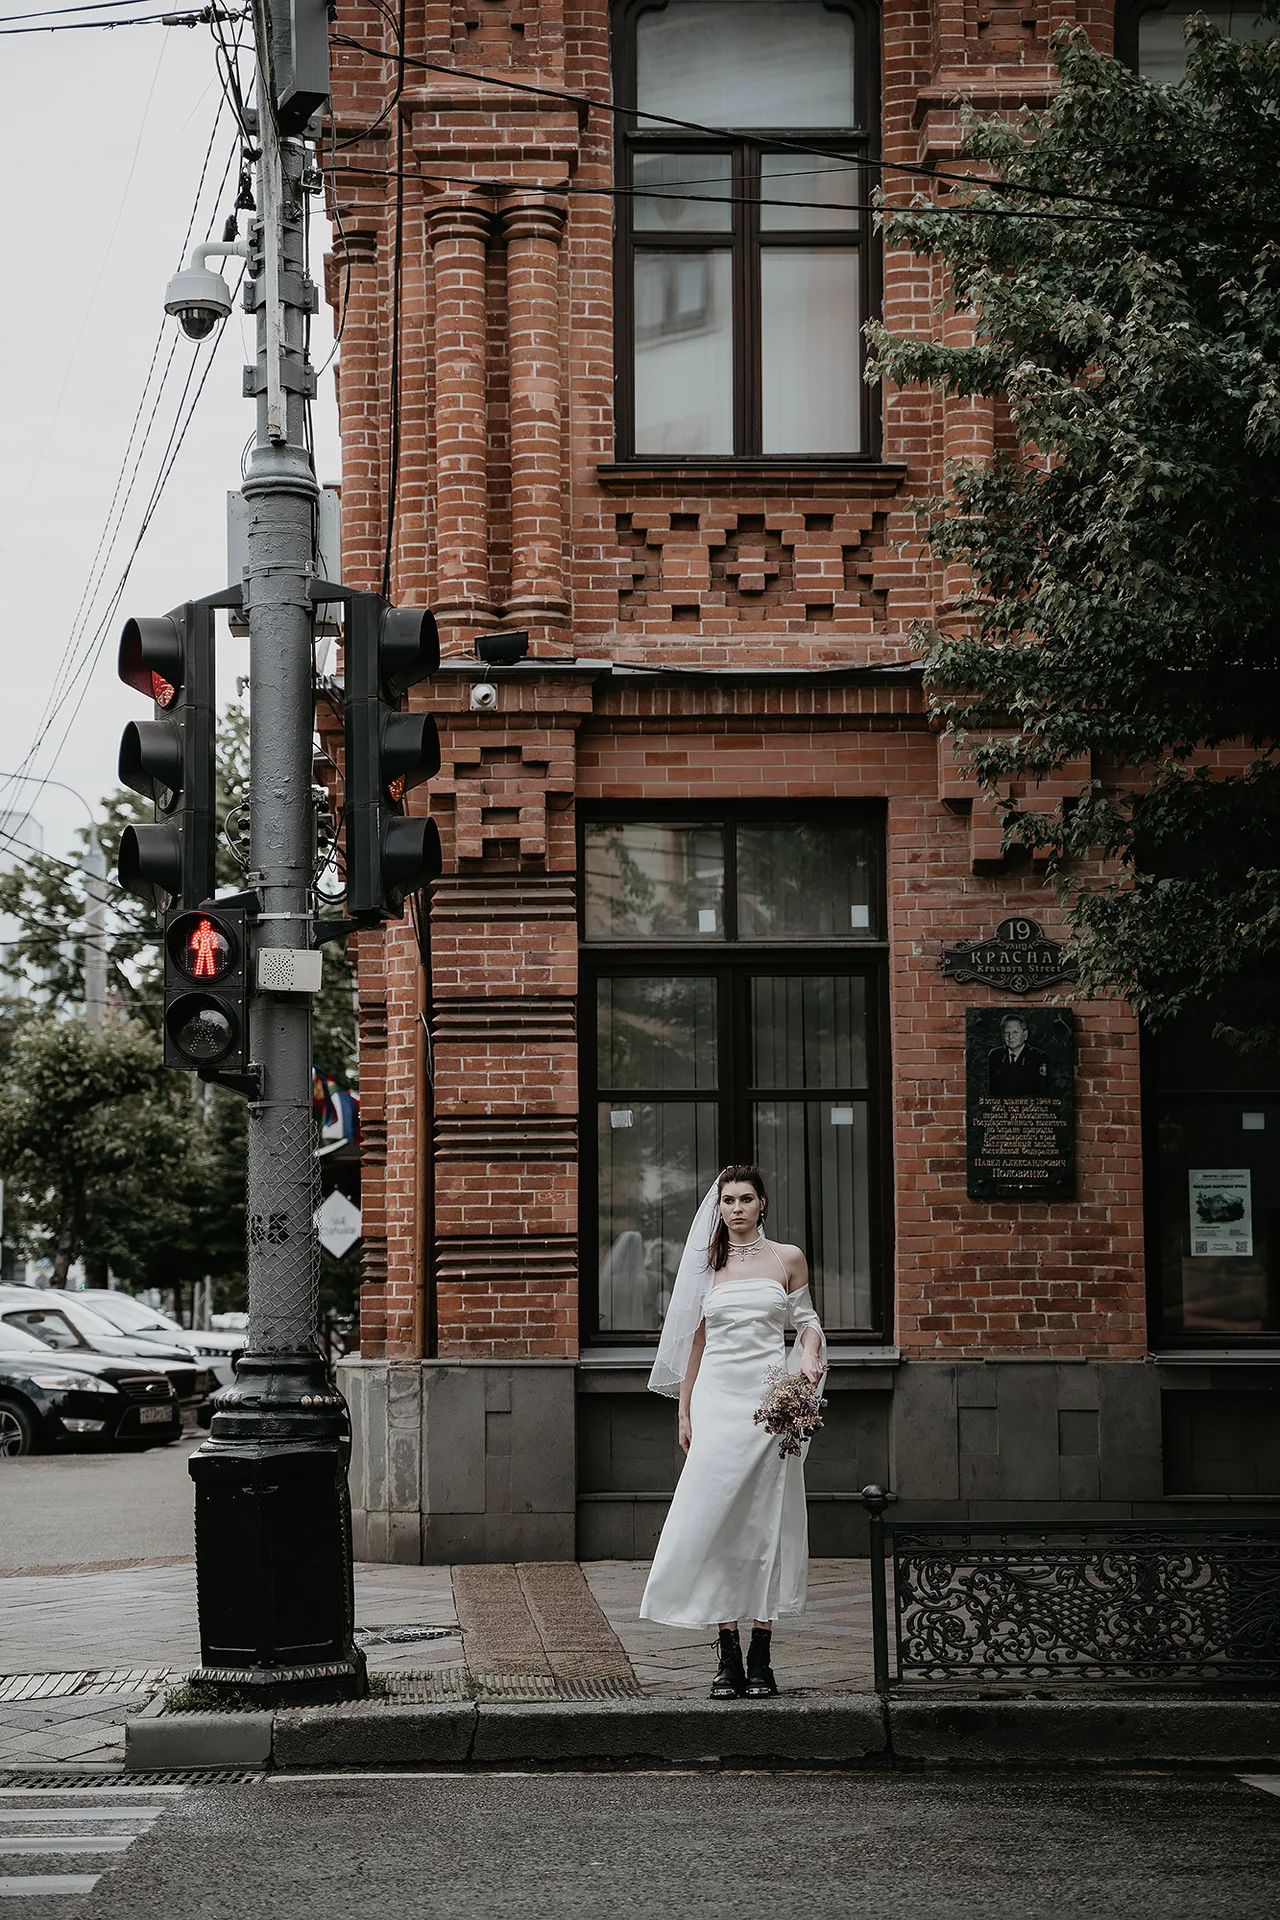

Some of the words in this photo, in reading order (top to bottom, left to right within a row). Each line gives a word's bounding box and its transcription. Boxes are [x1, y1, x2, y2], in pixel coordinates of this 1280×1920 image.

[1008, 921, 1030, 940] 19
[1004, 943, 1034, 951] УЛИЦА
[977, 965, 1023, 973] Krasnaya
[1028, 964, 1061, 972] Street
